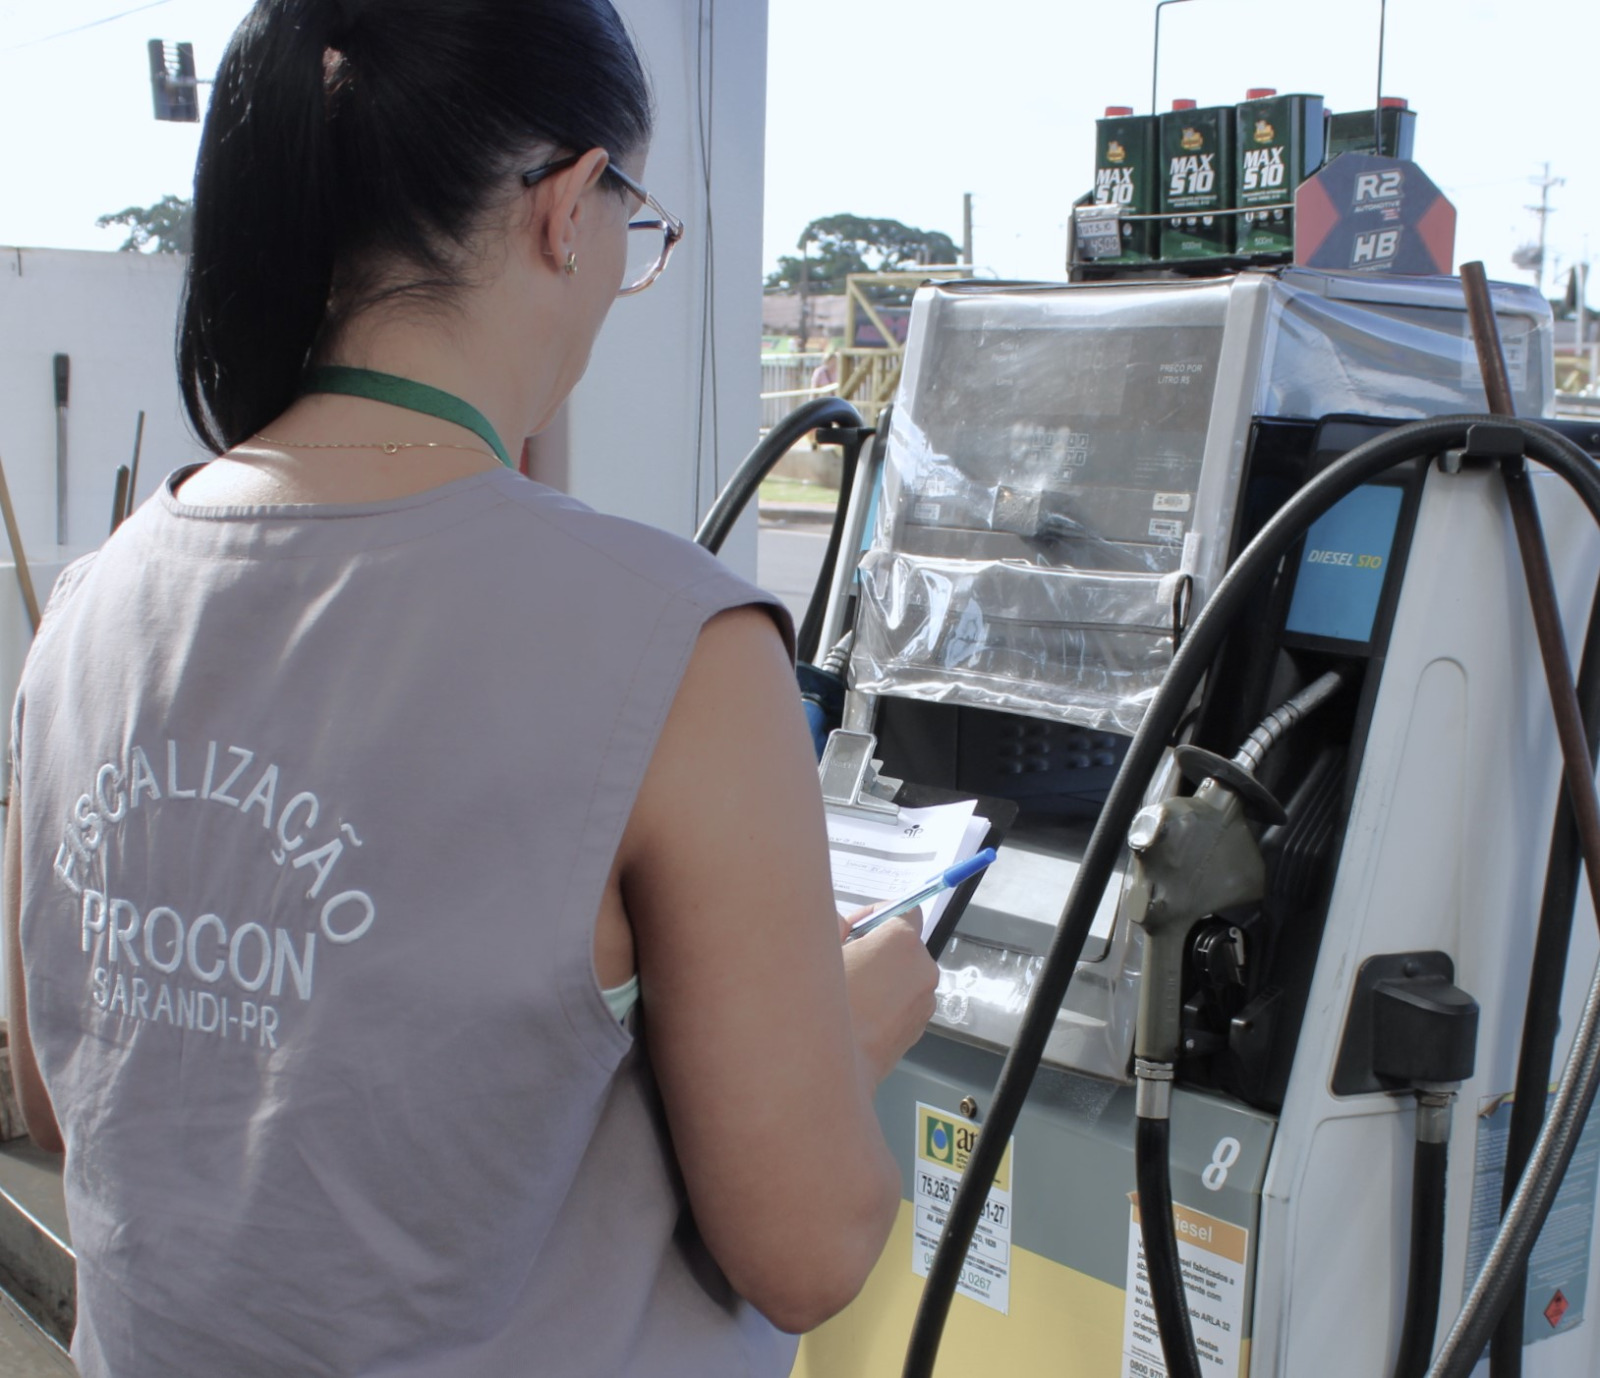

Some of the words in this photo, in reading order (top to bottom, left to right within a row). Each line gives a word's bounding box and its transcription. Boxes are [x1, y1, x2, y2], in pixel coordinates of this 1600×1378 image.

[1169, 153, 1215, 175] MAX
[1243, 146, 1284, 169] MAX
[1096, 166, 1134, 186] MAX
[1169, 170, 1215, 195] S10
[1243, 163, 1284, 190] S10
[1356, 170, 1401, 201] R2
[1095, 183, 1134, 205] S10
[1353, 230, 1398, 263] HB
[1187, 364, 1203, 374] POR
[1307, 549, 1353, 567] DIESEL
[1357, 554, 1383, 569] S10
[54, 740, 375, 943] FISCALIZAÇÃO
[82, 889, 316, 1000] PROCON
[93, 967, 280, 1049] SARANDI-PR
[1201, 1136, 1241, 1192] 8
[1174, 1213, 1213, 1244] iesel
[968, 1270, 992, 1292] 0267
[1200, 1312, 1222, 1328] ARLA
